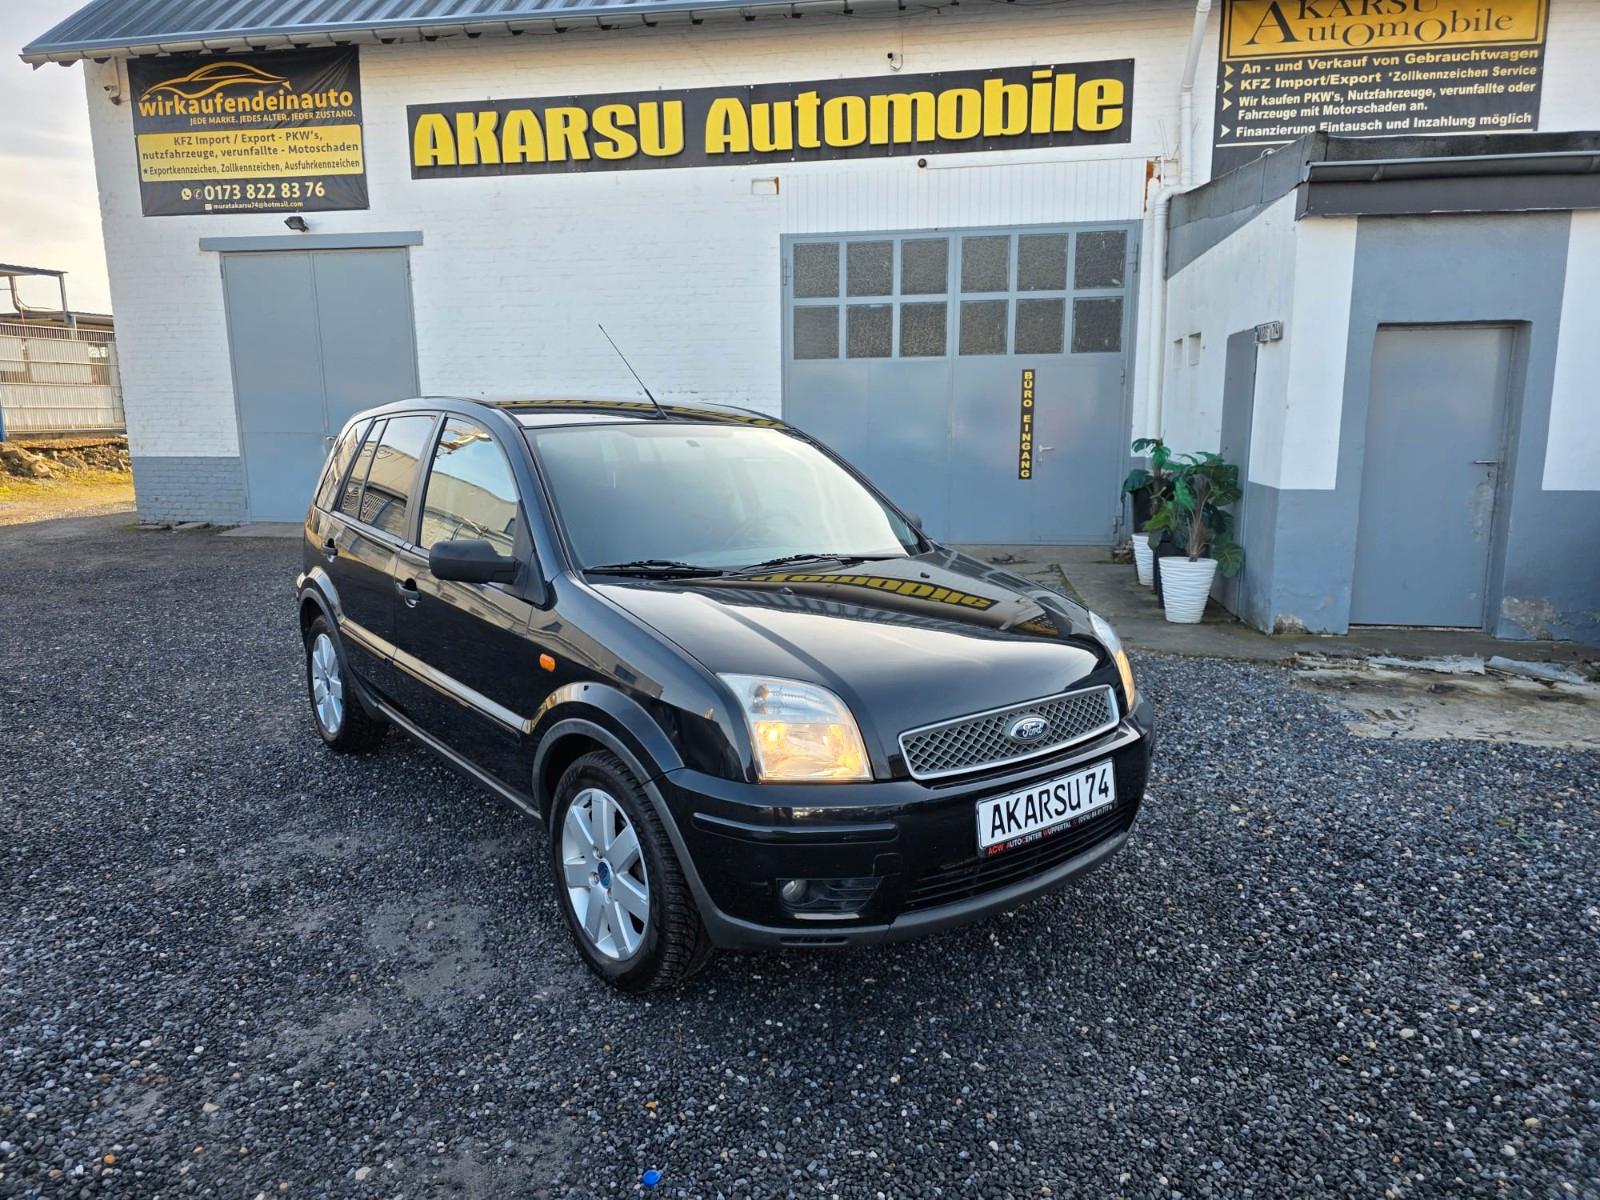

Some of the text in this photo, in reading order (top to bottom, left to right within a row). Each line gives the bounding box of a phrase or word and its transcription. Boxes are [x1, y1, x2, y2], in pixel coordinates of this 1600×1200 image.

[1241, 63, 1261, 74] An
[1275, 60, 1302, 72] und
[1307, 56, 1368, 70] Verkauf
[1372, 56, 1399, 66] von
[1405, 49, 1539, 64] Gebrauchtwagen
[1240, 78, 1271, 90] KFZ
[1275, 72, 1382, 90] Import/Export
[1492, 66, 1537, 77] Service
[138, 88, 354, 117] wirkaufendeinauto
[1239, 82, 1536, 107] Wir kaufen PKW's, Nutzfahrzeuge, verunfallte oder
[190, 110, 356, 126] JEDE MARKE. JEDES ALTER. JEDER ZUSTAND.
[413, 69, 1125, 167] AKARSU Automobile
[1238, 101, 1428, 121] Fahrzeuge mit Motorschaden an.
[1319, 119, 1383, 132] Eintausch
[1386, 117, 1410, 130] und
[1413, 115, 1475, 128] Inzahlung
[1479, 112, 1532, 126] möglich
[173, 136, 192, 145] KFZ
[195, 135, 231, 146] Import
[241, 133, 276, 145] Export
[285, 130, 323, 141] PKW's,
[142, 149, 218, 160] nutzfahrzeuge,
[220, 146, 279, 158] verunfallte
[288, 142, 359, 154] Motoschaden
[221, 161, 283, 174] Zollkennzeichen,
[204, 181, 325, 200] 0173 822 83 76
[1020, 415, 1031, 477] EINGANG
[990, 778, 1080, 838] AKARSU
[1085, 768, 1109, 804] 74
[988, 844, 1005, 855] ACW
